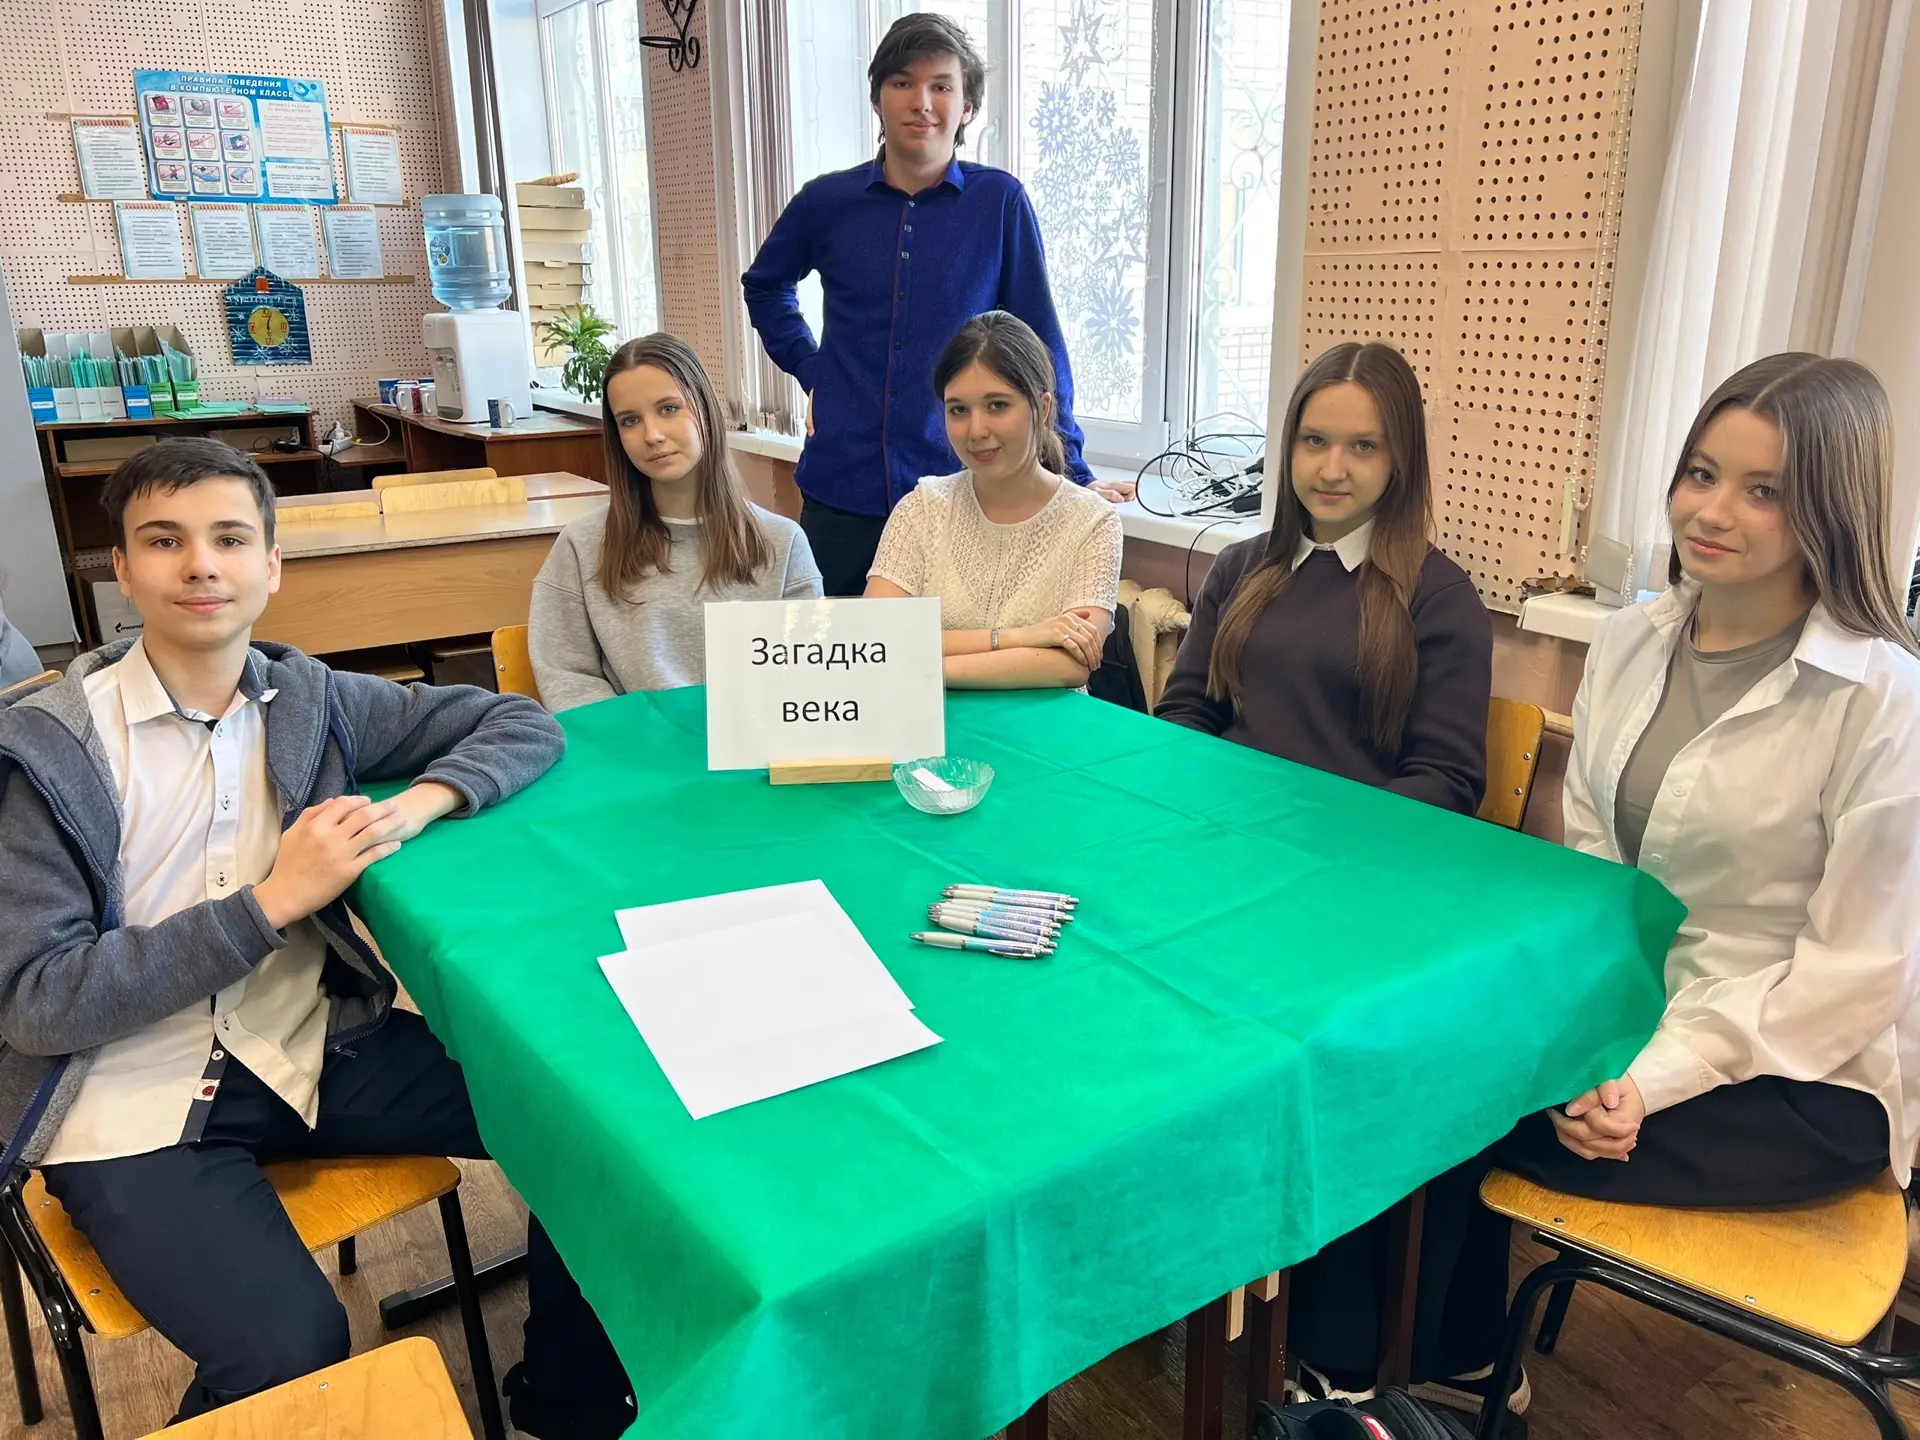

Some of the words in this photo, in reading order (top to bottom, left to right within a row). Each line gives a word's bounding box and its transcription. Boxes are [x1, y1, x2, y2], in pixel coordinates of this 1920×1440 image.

[181, 75, 223, 84] ПРАВИЛА
[226, 78, 281, 88] ПОВЕДЕНИЯ
[179, 85, 256, 95] КОМПЬЮТЕРНОМ
[259, 89, 293, 98] КЛАССЕ
[751, 637, 887, 670] Загадка
[782, 699, 860, 723] века
